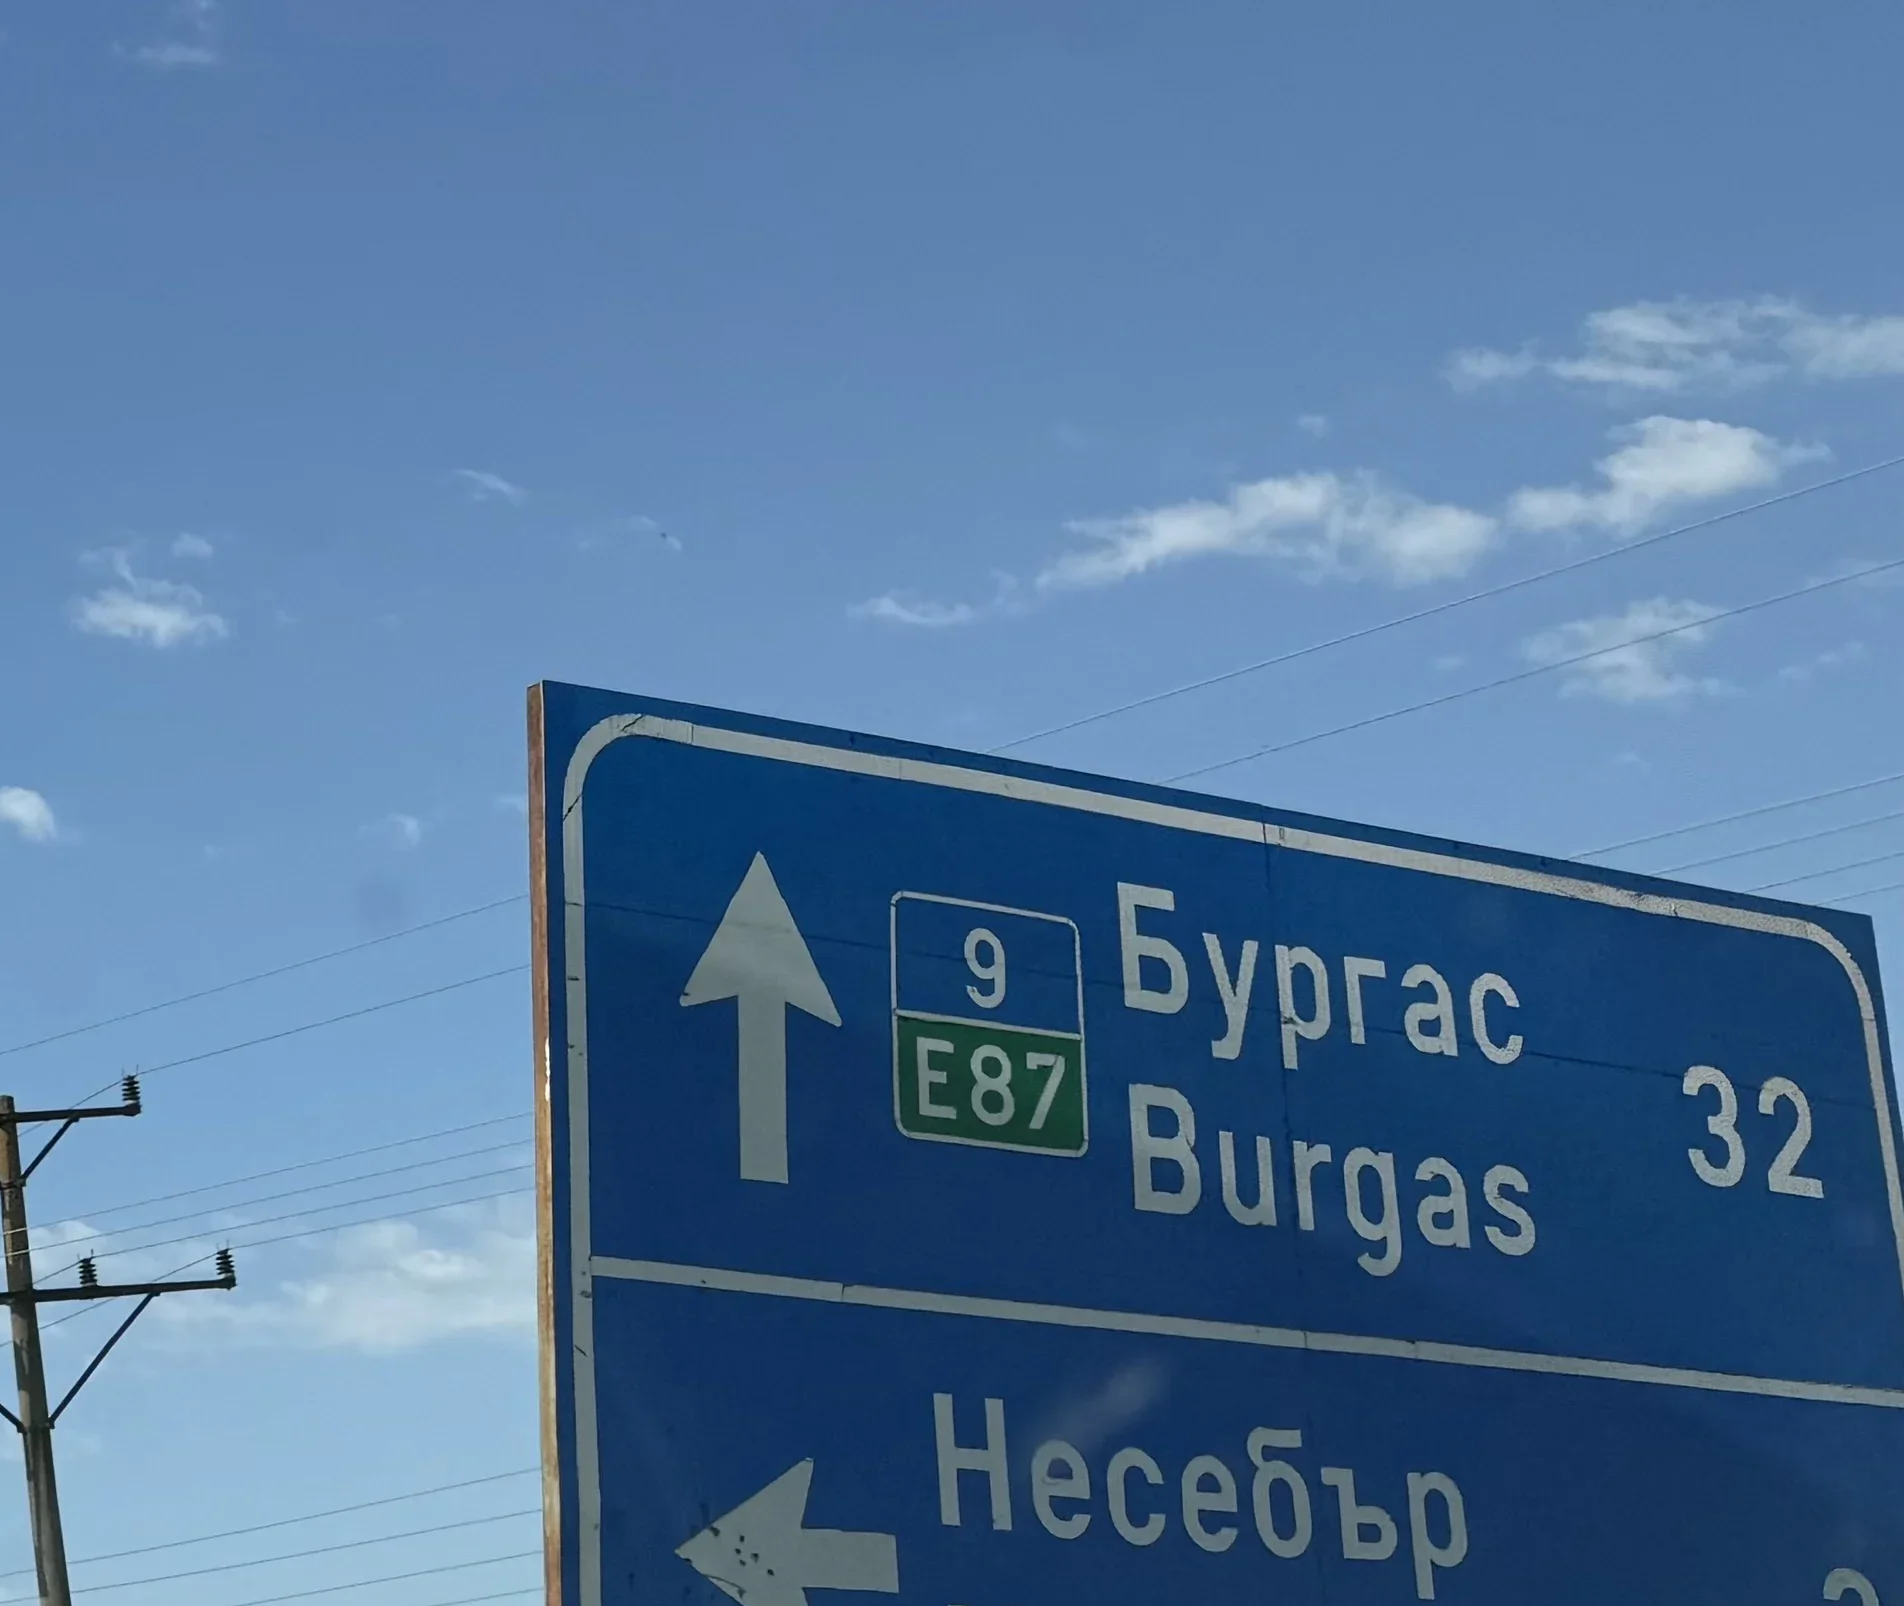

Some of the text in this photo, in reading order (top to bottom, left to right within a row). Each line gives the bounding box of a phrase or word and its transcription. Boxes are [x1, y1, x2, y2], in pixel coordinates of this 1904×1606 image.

[963, 927, 1007, 1010] 9
[1117, 880, 1524, 1071] Бургас
[915, 1036, 1066, 1130] E87
[1681, 1064, 1826, 1200] 32
[1127, 1082, 1537, 1277] Burgas
[932, 1392, 1469, 1601] Несебър
